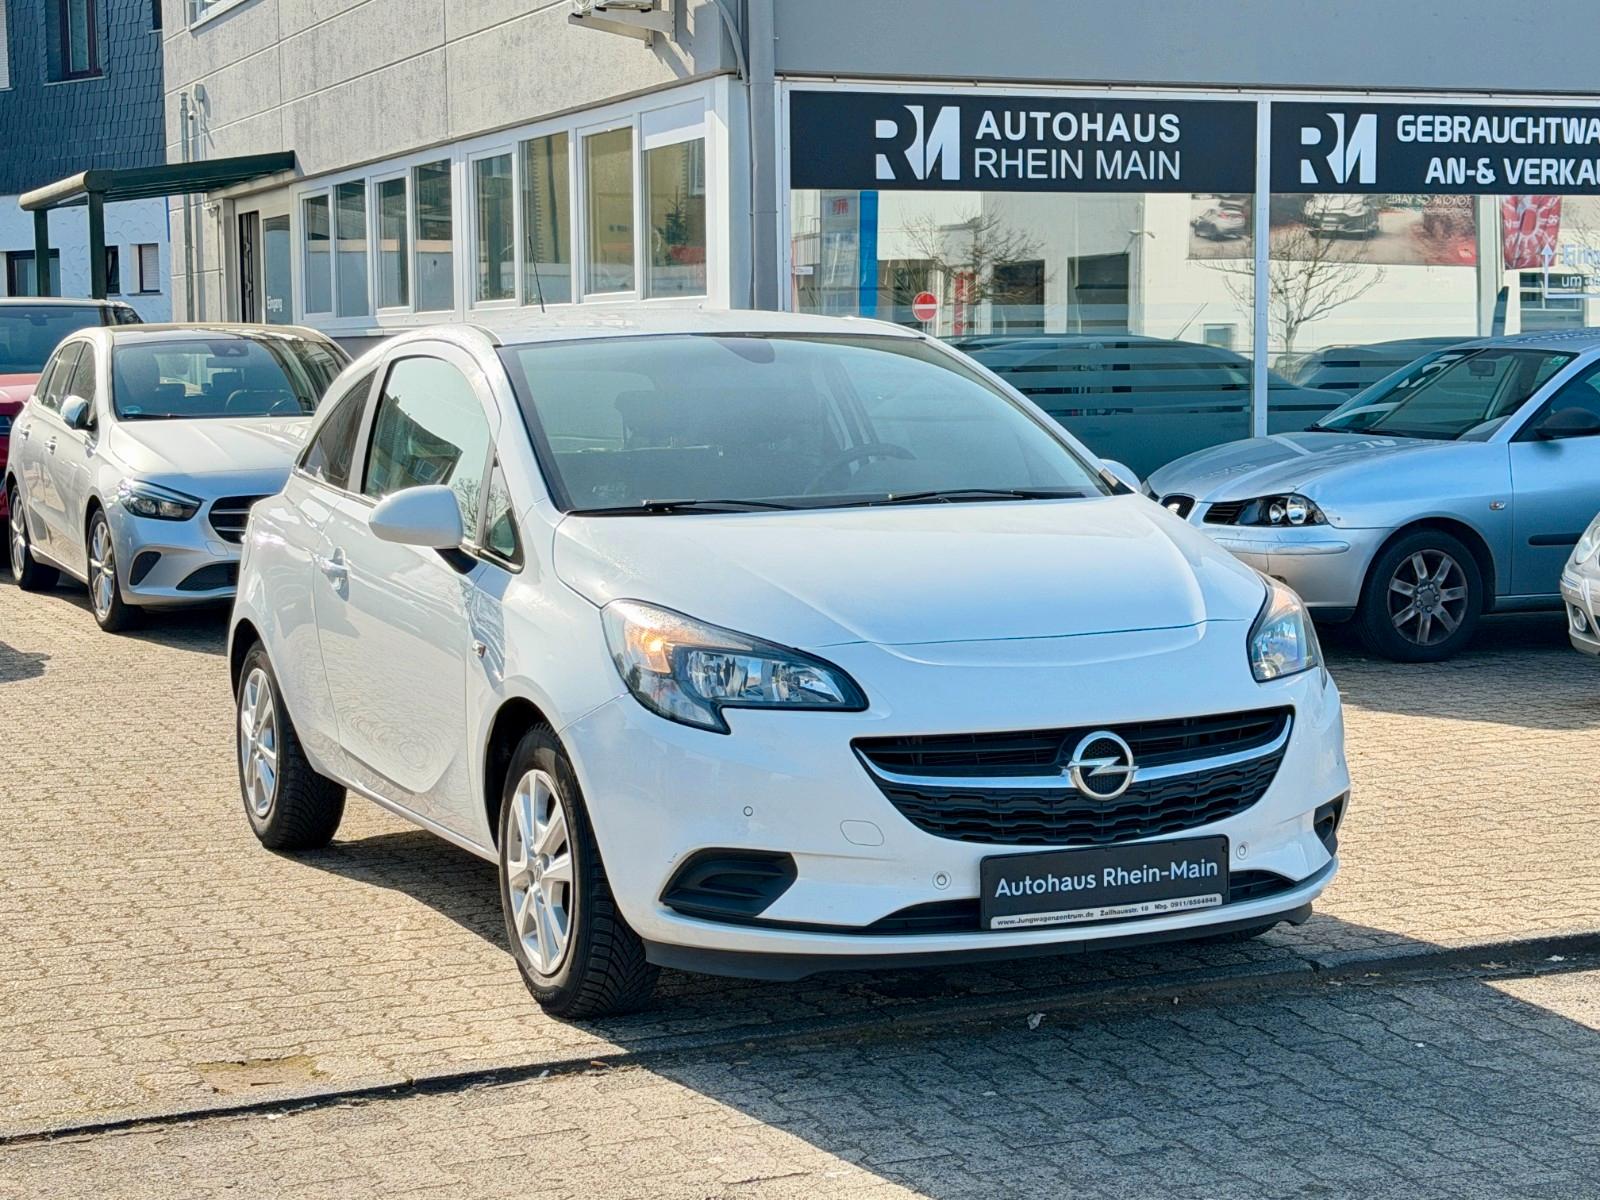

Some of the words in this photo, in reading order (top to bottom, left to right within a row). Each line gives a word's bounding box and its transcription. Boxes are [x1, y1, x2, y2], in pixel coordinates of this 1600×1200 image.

[974, 110, 1181, 143] AUTOHAUS
[1396, 114, 1600, 145] GEBRAUCHTWA
[974, 148, 1083, 180] RHEIN
[1095, 149, 1181, 181] MAIN
[1502, 158, 1600, 185] VERKA
[1561, 276, 1582, 287] um
[994, 874, 1096, 898] Autohaus
[1103, 858, 1218, 888] Rhein-Main
